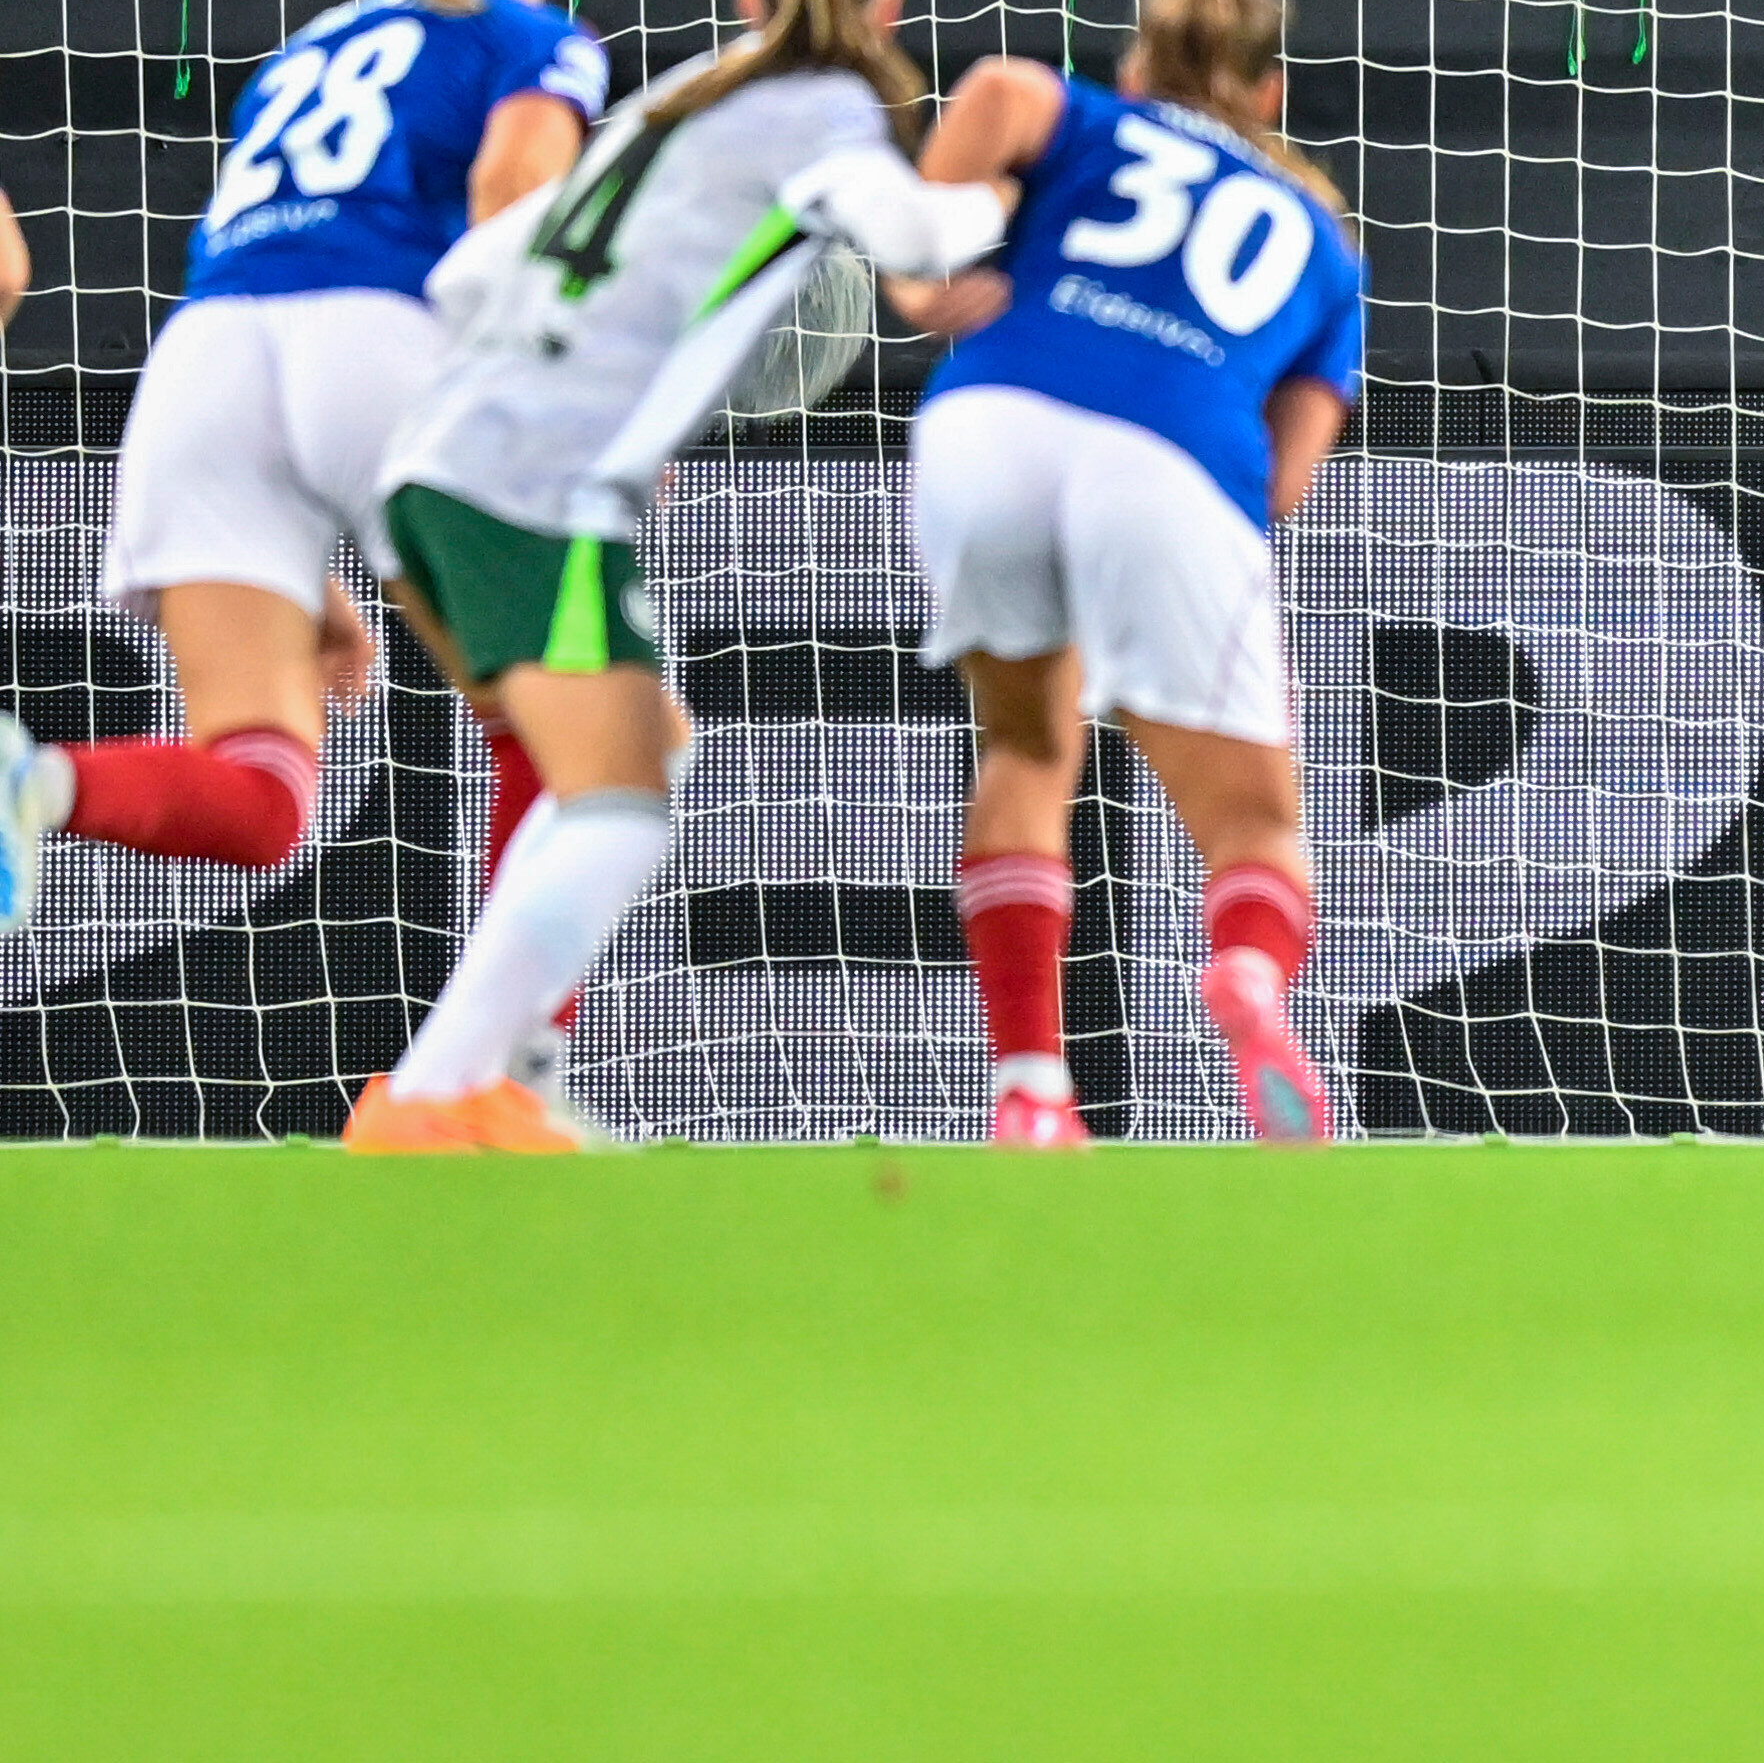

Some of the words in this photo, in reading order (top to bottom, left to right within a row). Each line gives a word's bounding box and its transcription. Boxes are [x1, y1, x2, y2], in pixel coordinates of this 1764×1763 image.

[205, 17, 426, 232] 28
[528, 110, 678, 298] 4
[1060, 113, 1315, 337] 30
